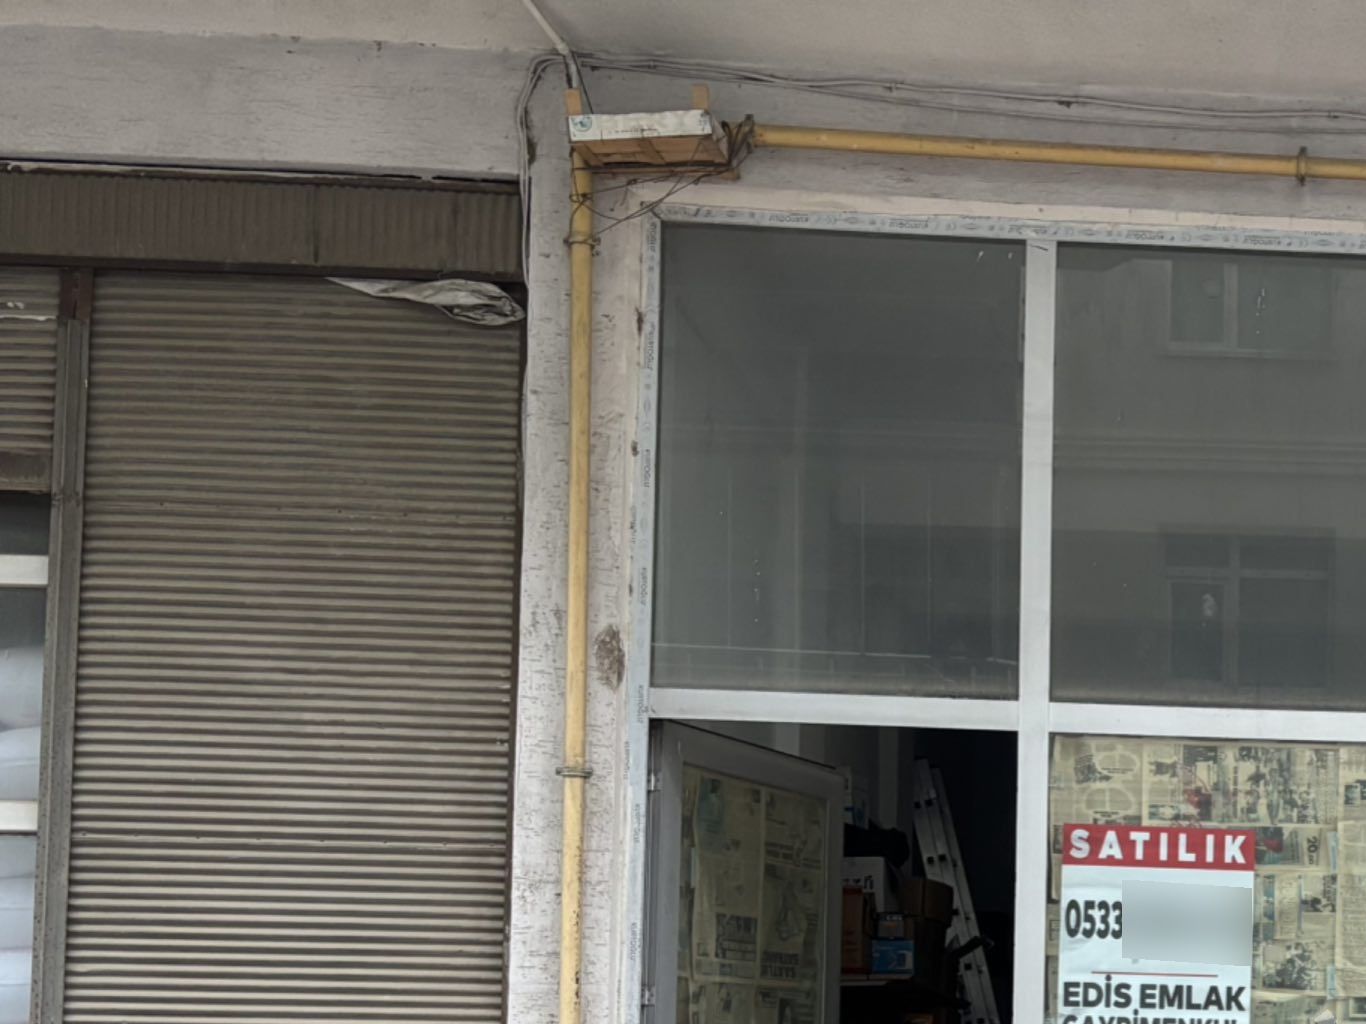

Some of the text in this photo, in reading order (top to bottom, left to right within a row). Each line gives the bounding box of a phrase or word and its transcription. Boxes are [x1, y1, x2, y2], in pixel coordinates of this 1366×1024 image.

[1069, 828, 1247, 865] SATILIK
[1065, 899, 1123, 939] 0533
[1139, 983, 1246, 1012] EMLAK
